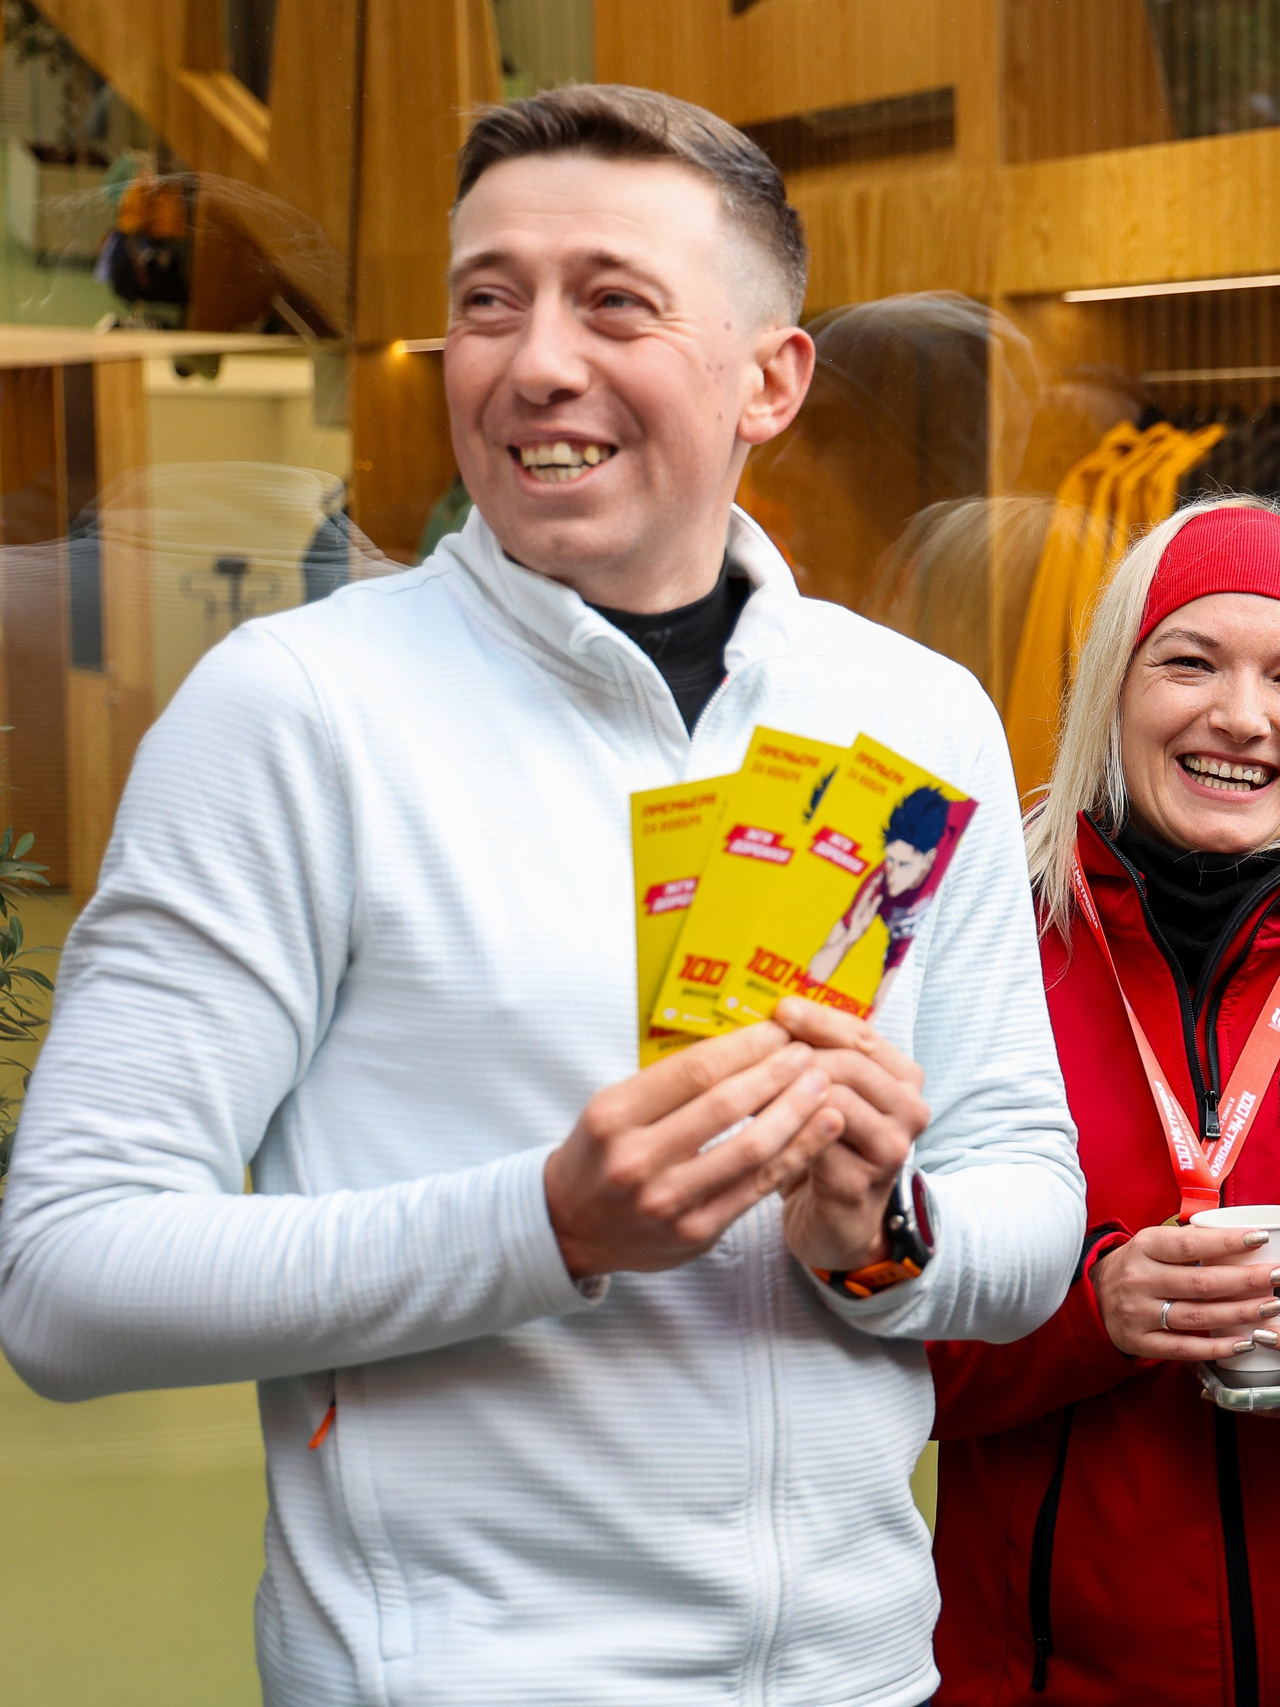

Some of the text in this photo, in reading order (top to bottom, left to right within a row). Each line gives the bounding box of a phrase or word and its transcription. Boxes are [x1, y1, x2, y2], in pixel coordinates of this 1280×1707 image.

[679, 953, 731, 987] 100
[746, 946, 793, 985] 100
[1221, 1102, 1233, 1121] КИНО
[1235, 1090, 1256, 1118] 100
[1174, 1145, 1194, 1170] 100
